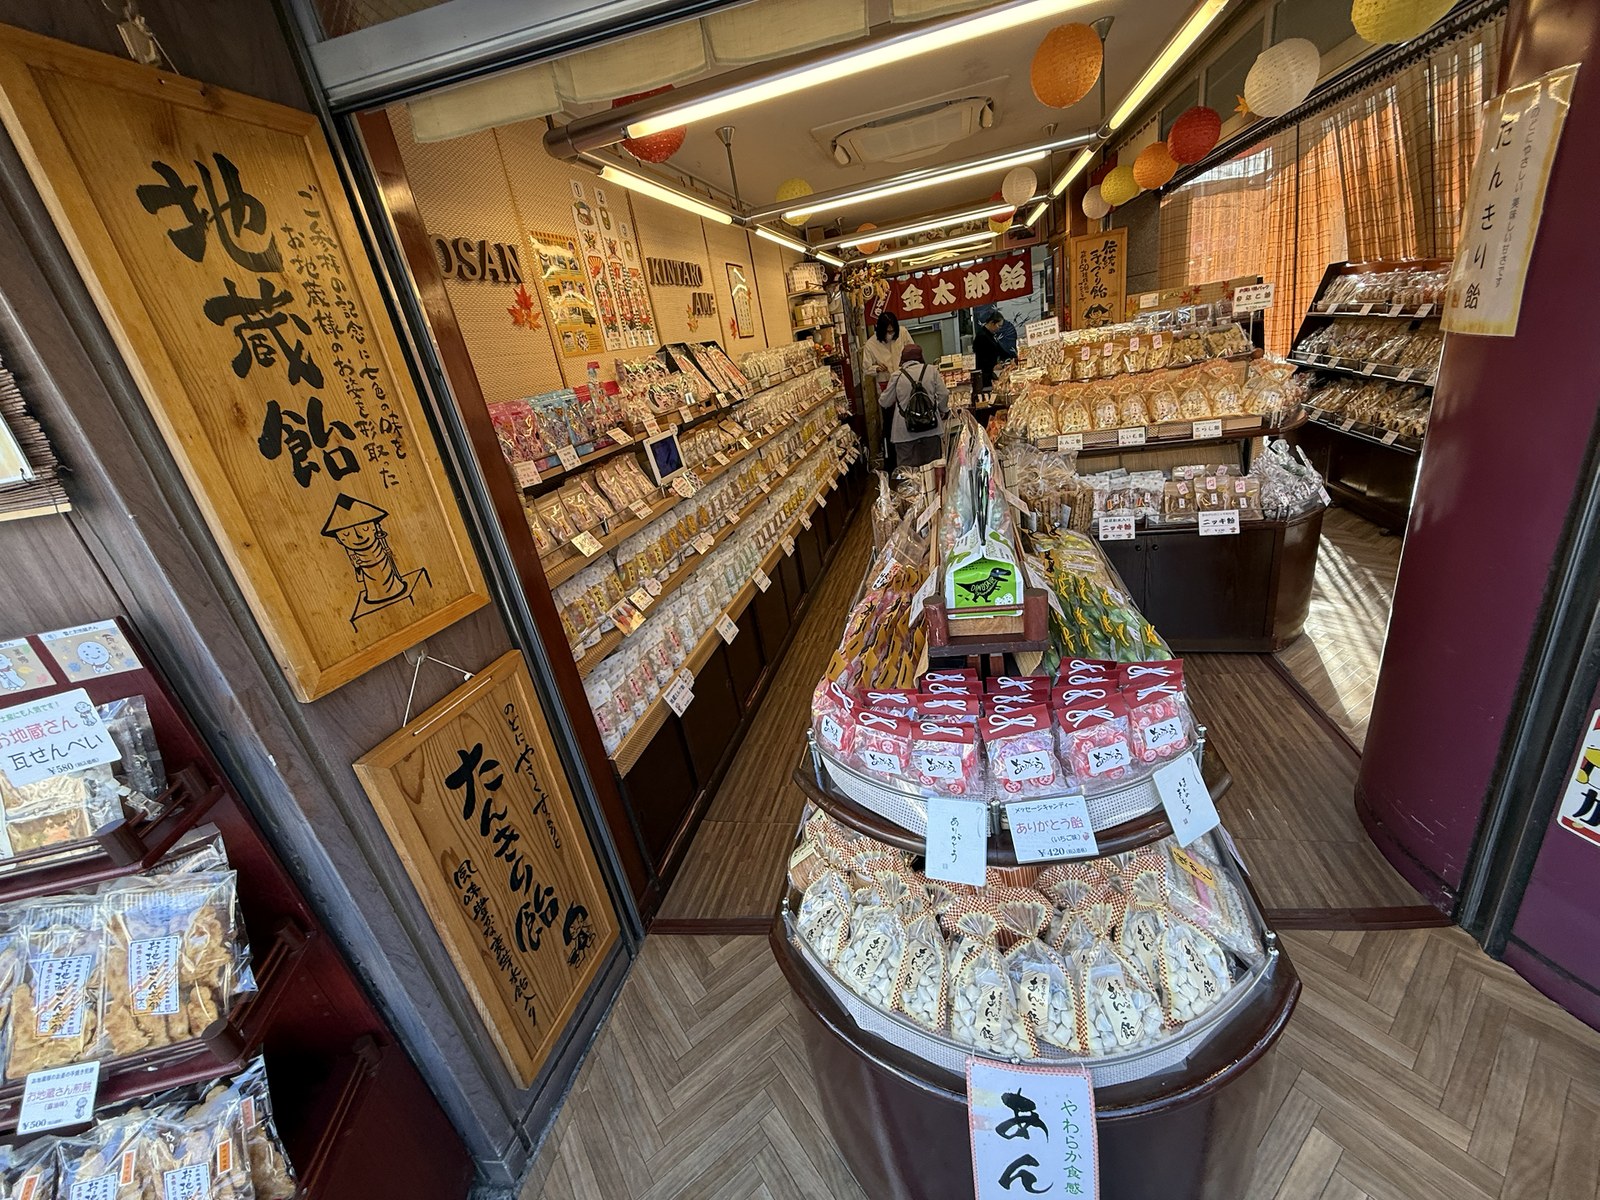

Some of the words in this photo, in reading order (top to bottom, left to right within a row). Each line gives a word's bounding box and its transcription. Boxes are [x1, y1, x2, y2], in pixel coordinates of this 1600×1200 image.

[1463, 119, 1515, 310] たんきり飴
[647, 257, 703, 287] KINTARO
[901, 260, 1028, 312] 金太郎飴
[135, 152, 361, 488] 地蔵飴
[1203, 517, 1235, 526] ニッキ飴
[7, 734, 104, 772] 瓦せんべい
[48, 762, 74, 775] ¥580
[1013, 801, 1076, 815] メッセージキャンディー
[1016, 816, 1084, 835] ありがとう飴
[445, 742, 559, 954] たんきり飴
[1037, 847, 1065, 858] ¥420
[22, 1118, 47, 1131] ¥500
[995, 1087, 1054, 1195] あん
[1060, 1099, 1084, 1195] やわらか食感
